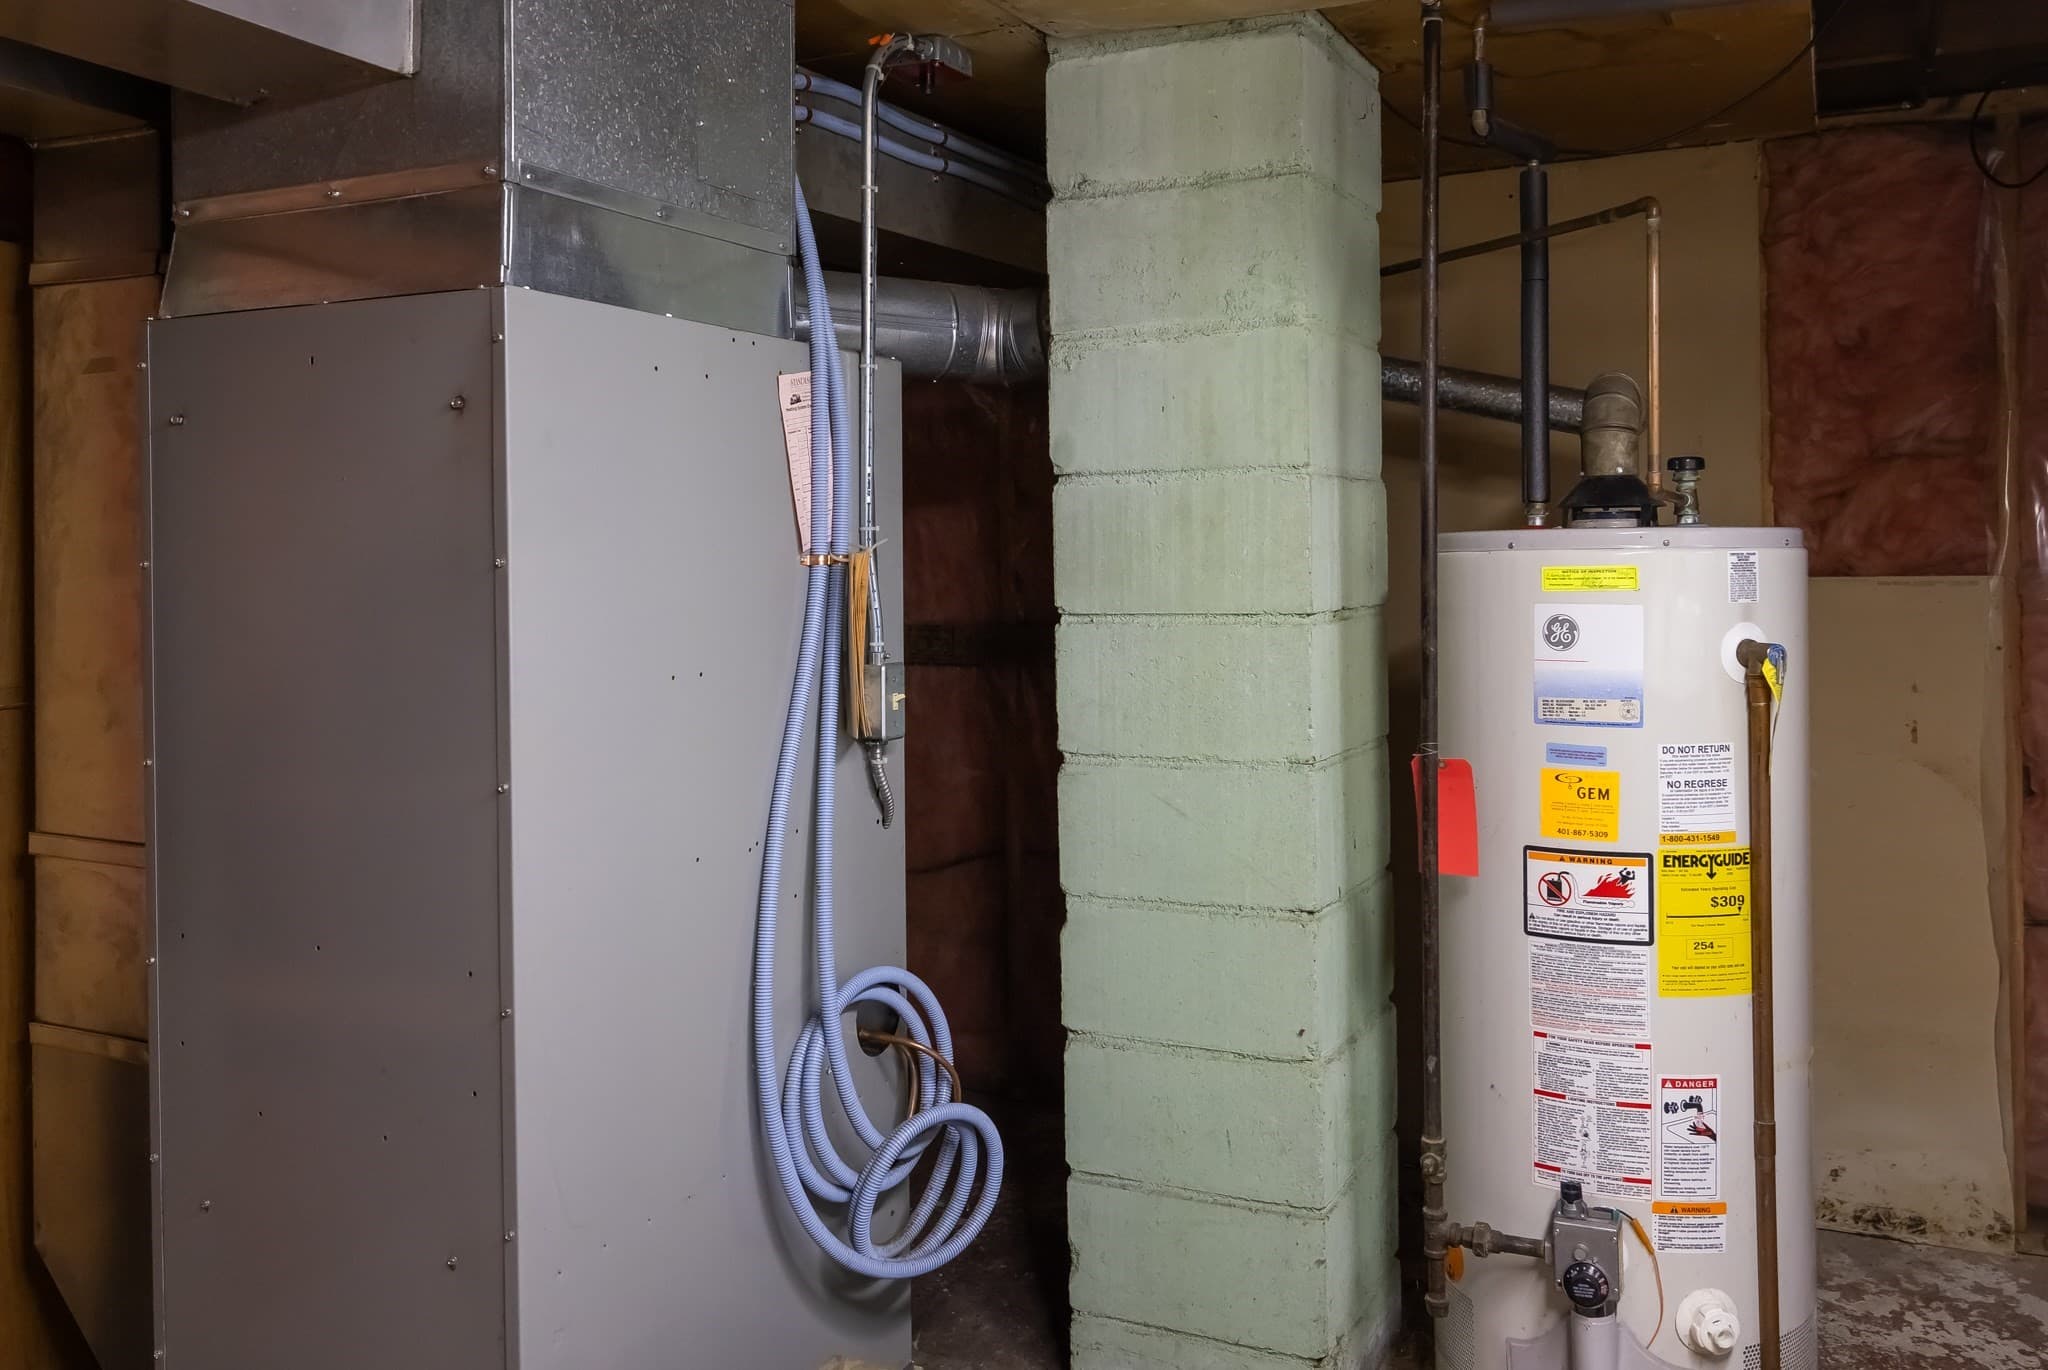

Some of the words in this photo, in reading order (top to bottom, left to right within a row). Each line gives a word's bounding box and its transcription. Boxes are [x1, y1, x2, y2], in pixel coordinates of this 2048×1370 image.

[1662, 746, 1676, 755] DO
[1678, 745, 1696, 754] NOT
[1698, 744, 1731, 754] RETURN
[1666, 780, 1682, 789] NO
[1684, 779, 1729, 789] REGRESE
[1576, 787, 1610, 800] GEM
[1556, 827, 1609, 838] 401-867-5309
[1662, 833, 1720, 843] 1-800-431-1549
[1568, 856, 1613, 865] WARNING
[1663, 852, 1750, 869] ENERGYGUIDE
[1710, 894, 1745, 908] $309
[1693, 941, 1714, 950] 254
[1675, 1080, 1715, 1088] DANGER
